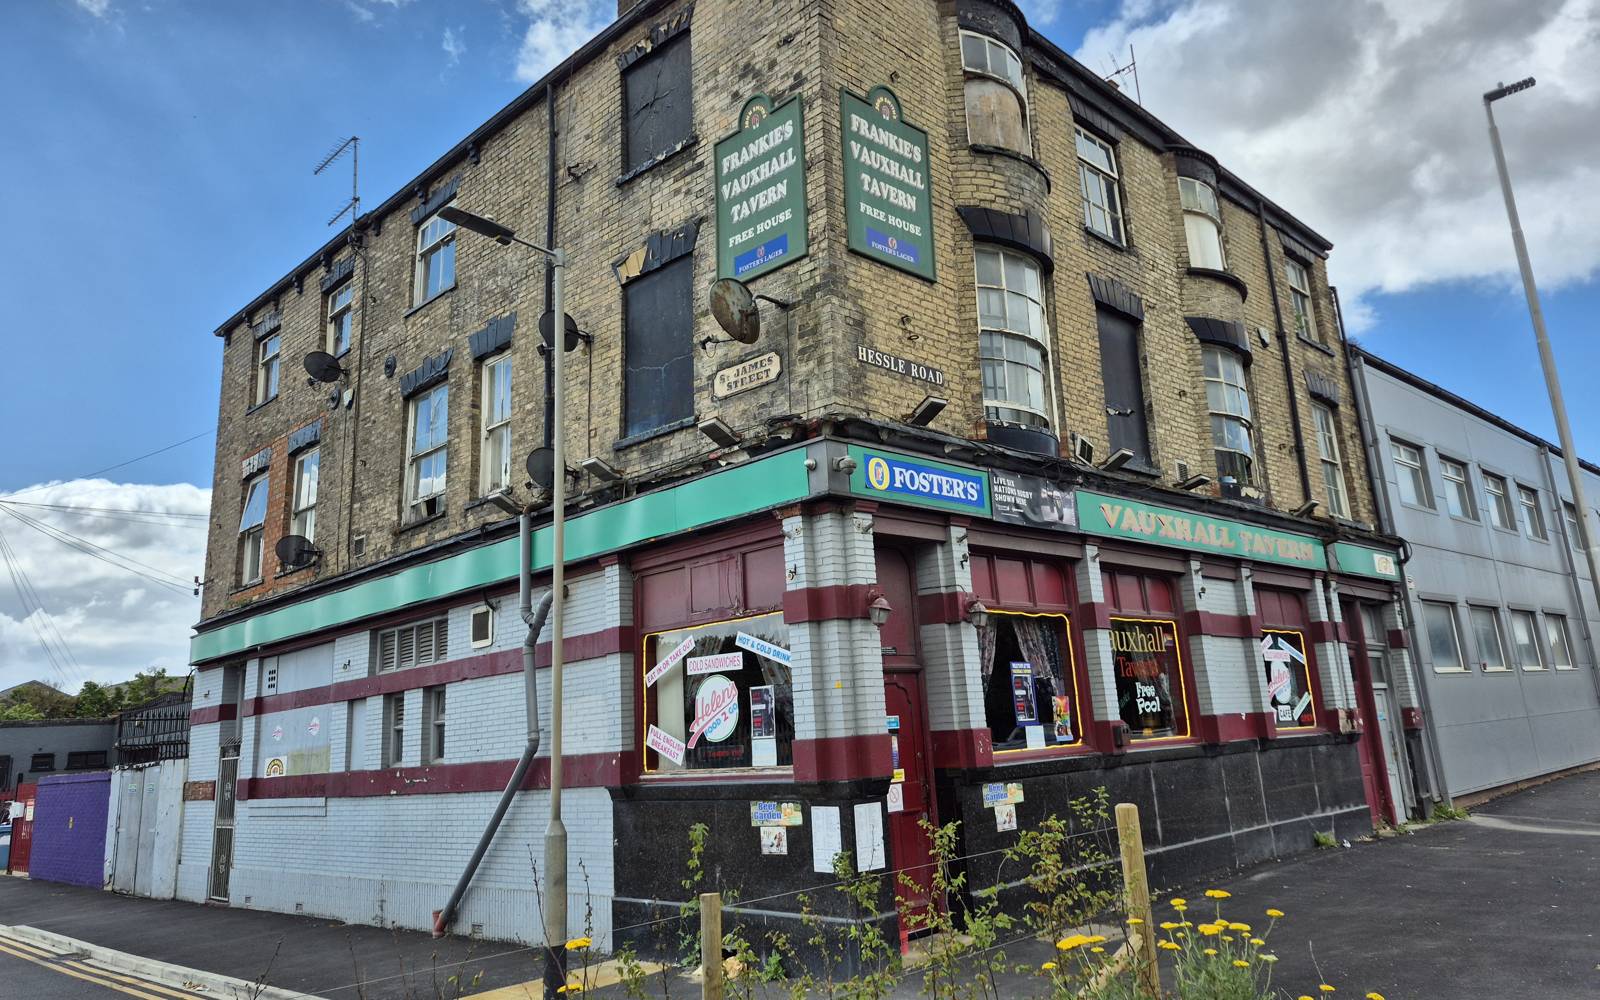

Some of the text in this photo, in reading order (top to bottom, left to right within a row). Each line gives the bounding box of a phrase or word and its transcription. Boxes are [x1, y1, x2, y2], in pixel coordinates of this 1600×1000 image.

[721, 119, 794, 176] FRANKIE'S
[849, 113, 922, 163] FRANKIE'S
[720, 147, 797, 202] VAUXHALL
[849, 140, 925, 190] VAUXHALL
[730, 179, 788, 224] TAVERN
[860, 172, 917, 212] TAVERN
[728, 208, 793, 248] FREE HOUSE
[859, 201, 922, 236] FREE HOUSE
[738, 248, 783, 273] FOSTER'S LAGER
[871, 241, 915, 263] FOSTER'S LAGER
[726, 368, 771, 391] STREET
[857, 346, 943, 385] HESSLE ROAD
[893, 467, 978, 501] FOSTER'S
[993, 476, 1006, 486] LIVE
[1099, 503, 1314, 561] VAUXHALL TAVERN
[738, 635, 750, 645] HOT
[756, 643, 772, 654] COLD
[1108, 625, 1167, 652] auxhall
[647, 639, 693, 683] EAT IN OR TAKE OUT
[688, 655, 741, 672] COLD SANDWICHES
[1135, 682, 1156, 698] Free
[704, 702, 738, 737] FOOD 2 GO
[1136, 697, 1161, 715] Pool
[651, 738, 679, 760] BREAKFAST
[662, 734, 684, 753] ENGLISH
[753, 811, 782, 820] Garden
[757, 802, 776, 811] Beer
